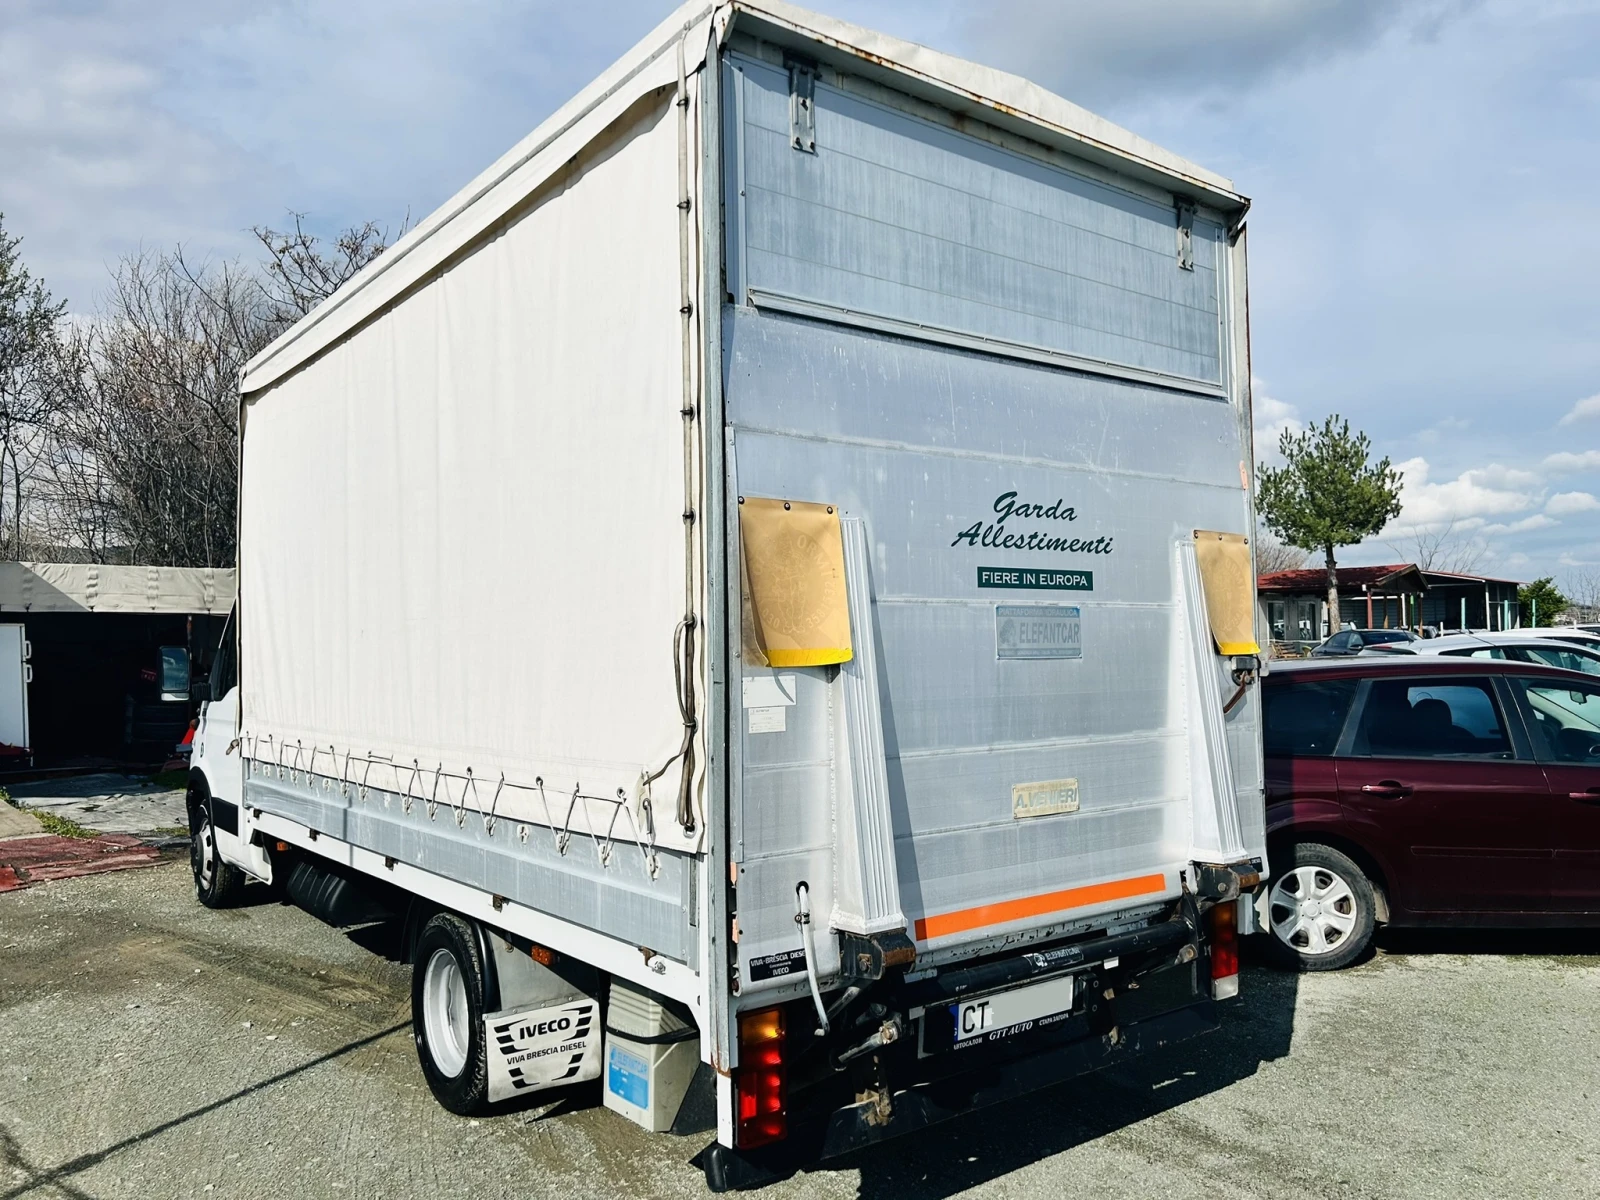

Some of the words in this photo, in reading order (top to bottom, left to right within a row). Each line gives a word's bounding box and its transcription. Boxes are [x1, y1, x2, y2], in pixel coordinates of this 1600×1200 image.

[993, 491, 1078, 525] Garda
[951, 521, 1114, 555] Allestimenti
[982, 571, 1020, 584] FIERE
[1023, 573, 1036, 585] IN
[1039, 574, 1088, 587] EUROPA
[1019, 622, 1080, 644] ELEFANTCAR
[790, 950, 806, 959] DIESE
[772, 966, 790, 976] IVECO
[519, 1017, 571, 1040] IVECO
[989, 1028, 1010, 1040] GTT
[1008, 1021, 1033, 1036] AUTO
[506, 1053, 526, 1065] VIVA
[526, 1046, 559, 1060] BRESCIA
[560, 1040, 587, 1053] DIESEL
